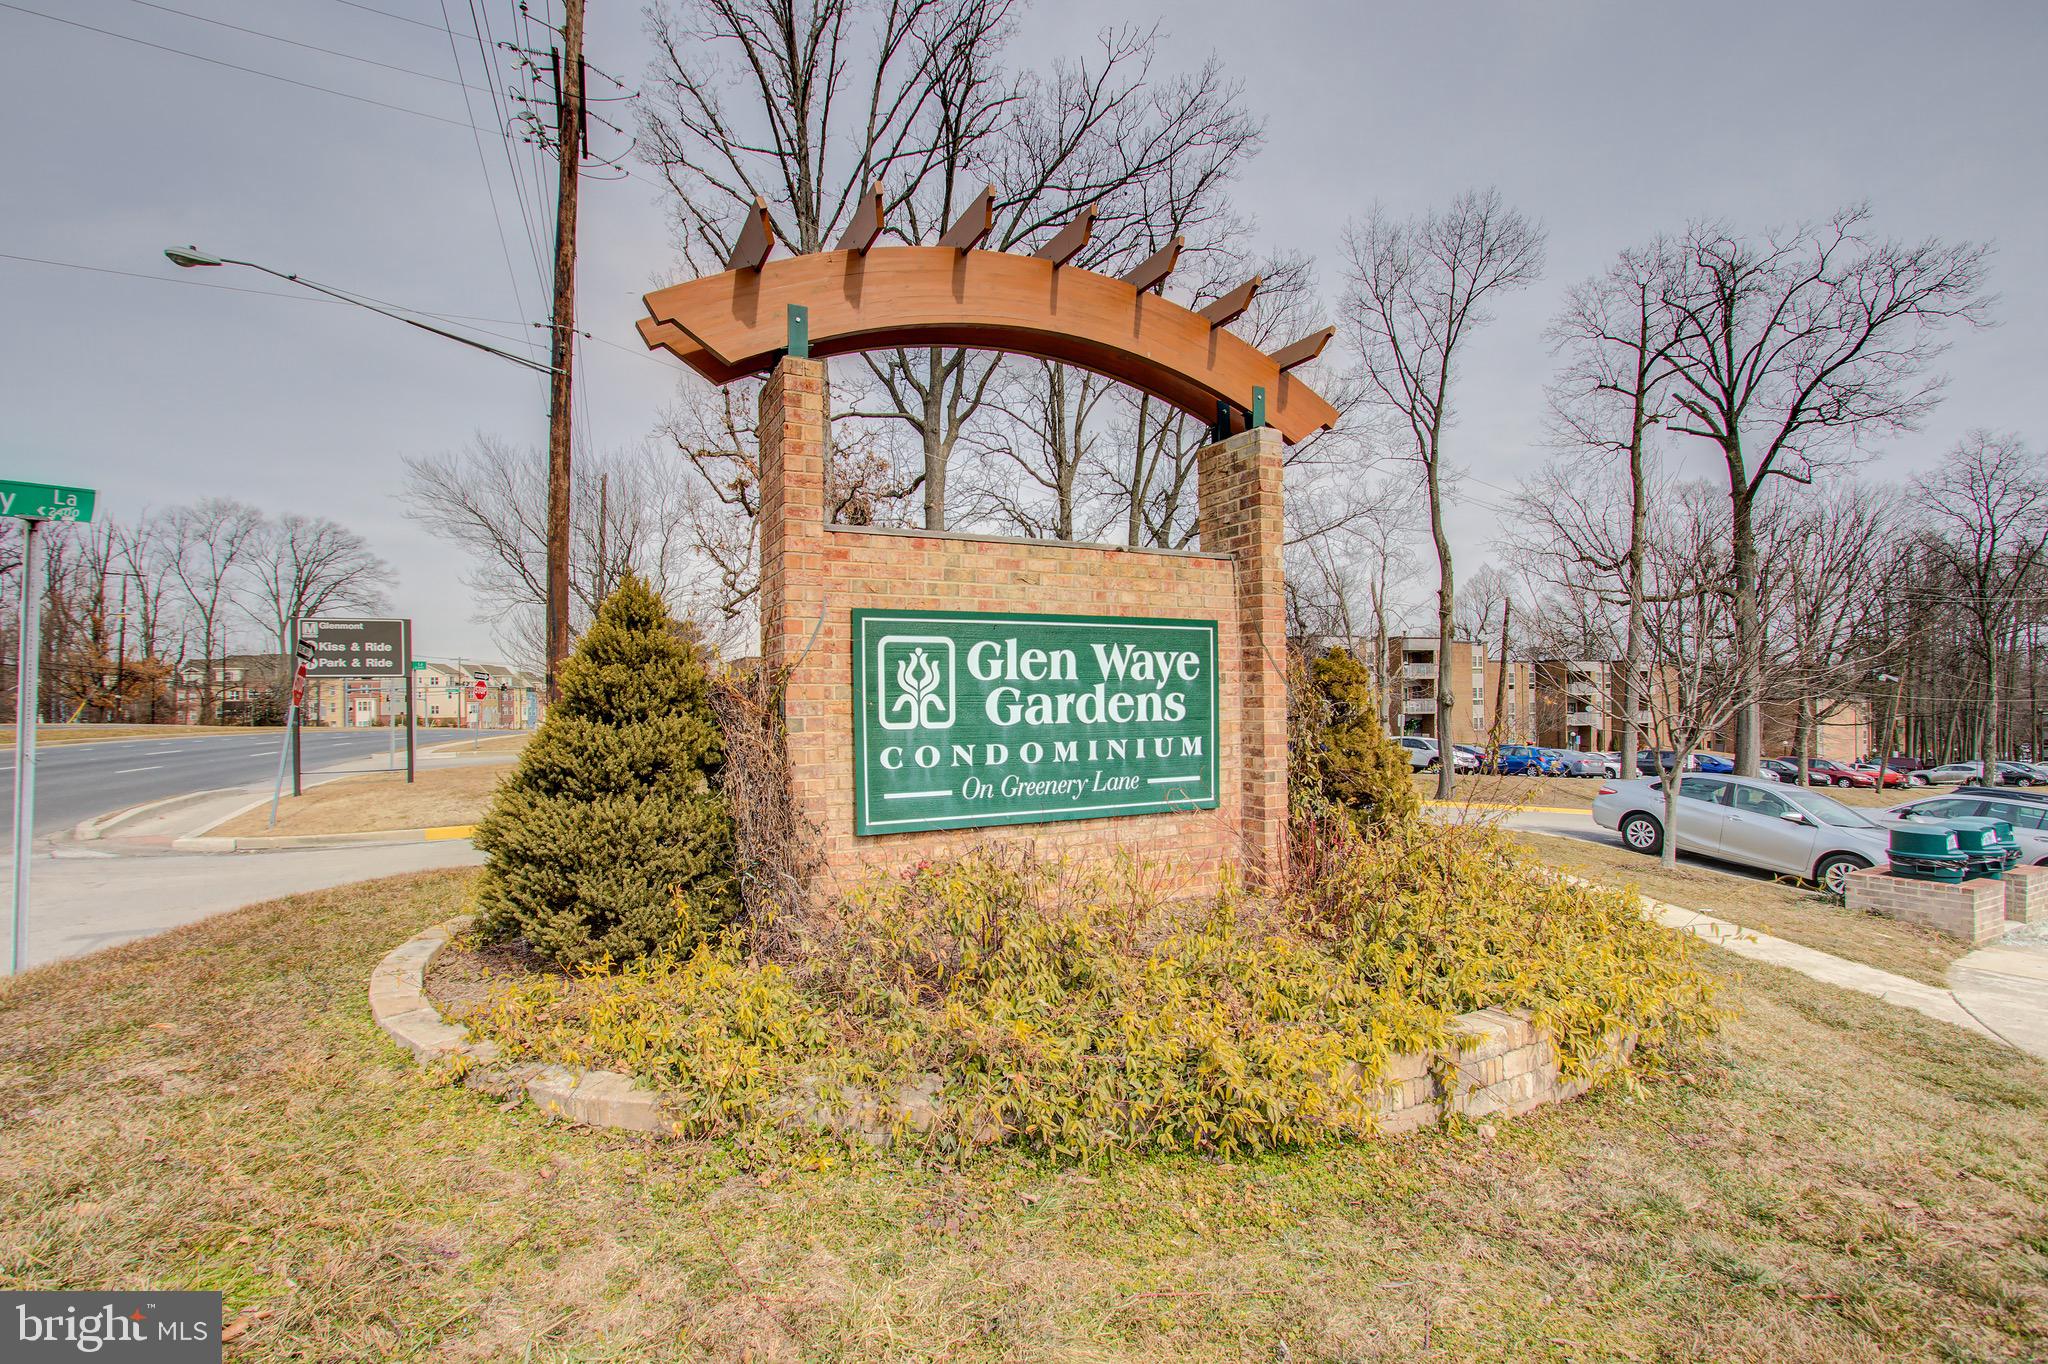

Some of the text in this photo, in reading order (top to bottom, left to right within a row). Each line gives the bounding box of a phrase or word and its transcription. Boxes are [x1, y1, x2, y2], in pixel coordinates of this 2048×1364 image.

[54, 489, 78, 507] La
[318, 621, 365, 630] Glenmont
[318, 641, 346, 652] Kiss
[350, 642, 360, 652] &
[364, 642, 393, 652] Ride
[318, 658, 394, 668] Park & Ride
[966, 637, 1201, 690] Glen Waye
[985, 683, 1187, 727] Gardens
[879, 735, 1204, 771] CONDOMINIUM
[962, 770, 1140, 801] On Greenery Lane
